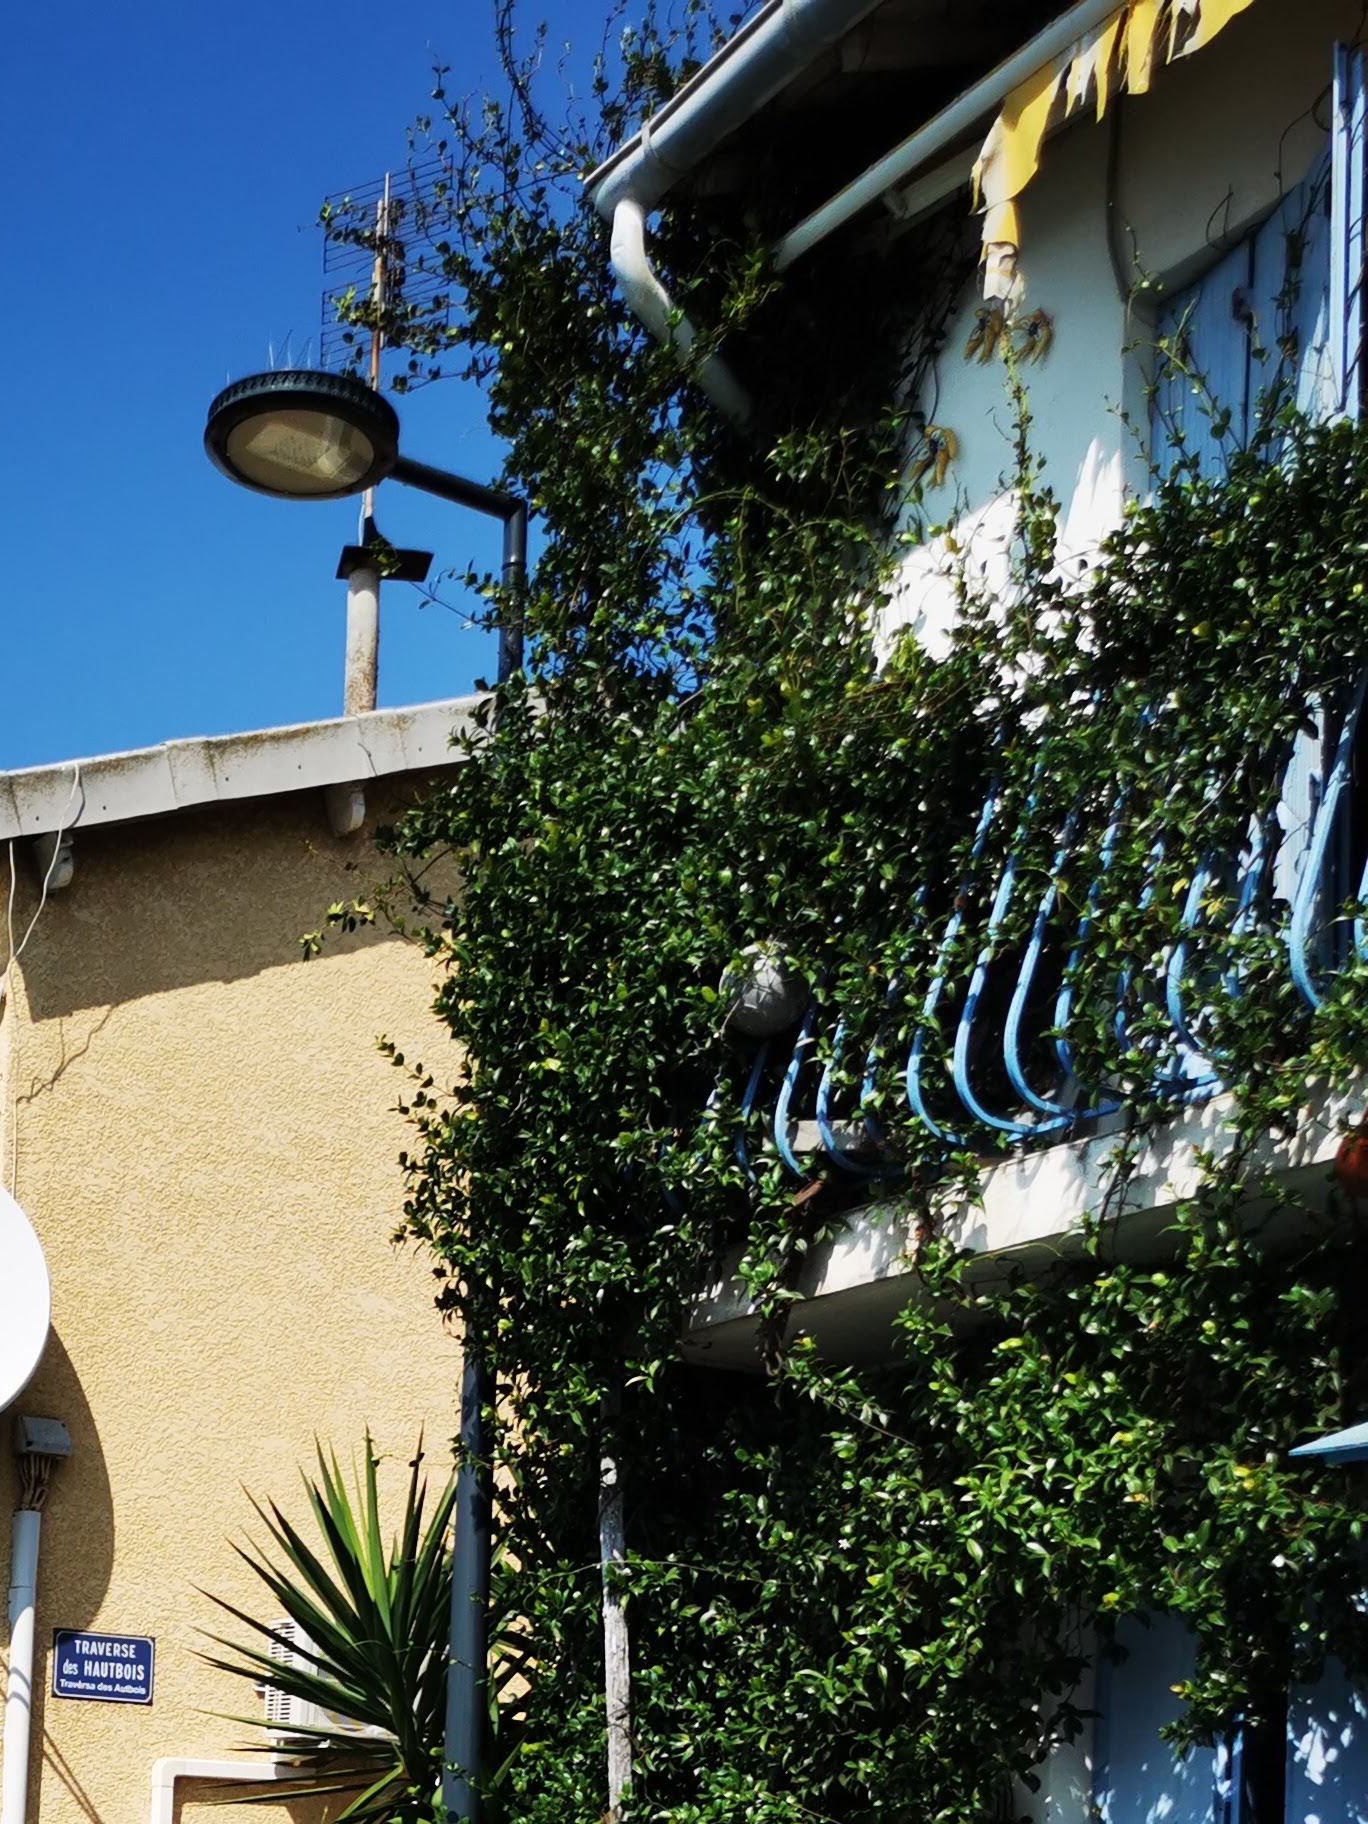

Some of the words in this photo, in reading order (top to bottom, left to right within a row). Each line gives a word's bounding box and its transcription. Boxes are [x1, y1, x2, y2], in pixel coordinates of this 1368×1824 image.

[74, 1639, 136, 1659] TRAVERSE
[62, 1658, 79, 1676] des
[84, 1659, 145, 1681] HAUTBOIS
